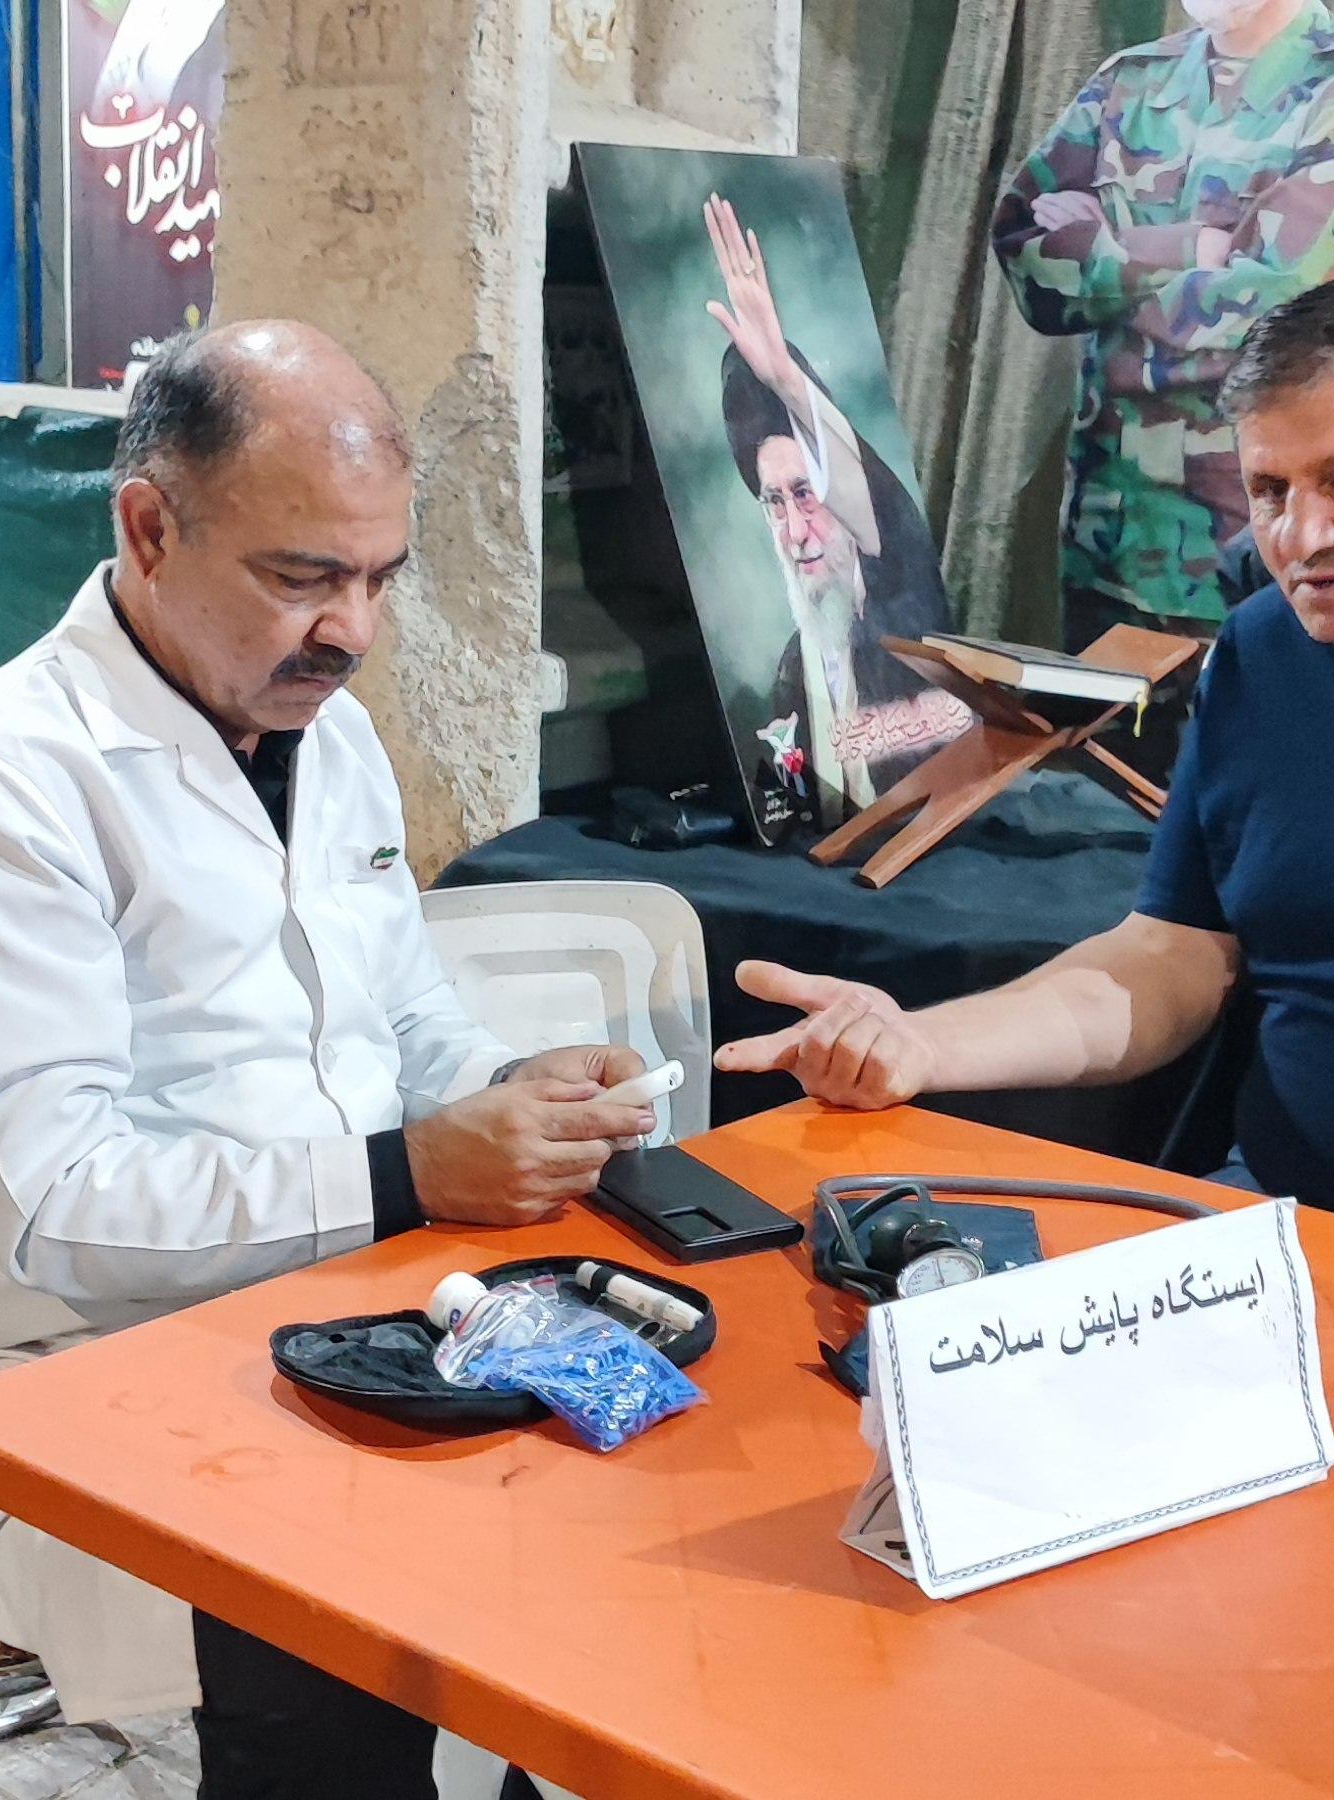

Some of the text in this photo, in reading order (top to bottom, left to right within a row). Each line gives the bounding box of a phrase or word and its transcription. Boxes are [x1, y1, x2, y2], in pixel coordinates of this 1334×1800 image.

[79, 93, 205, 225] انقلاب
[929, 1257, 1265, 1374] ایستگاه پایش سلامت
